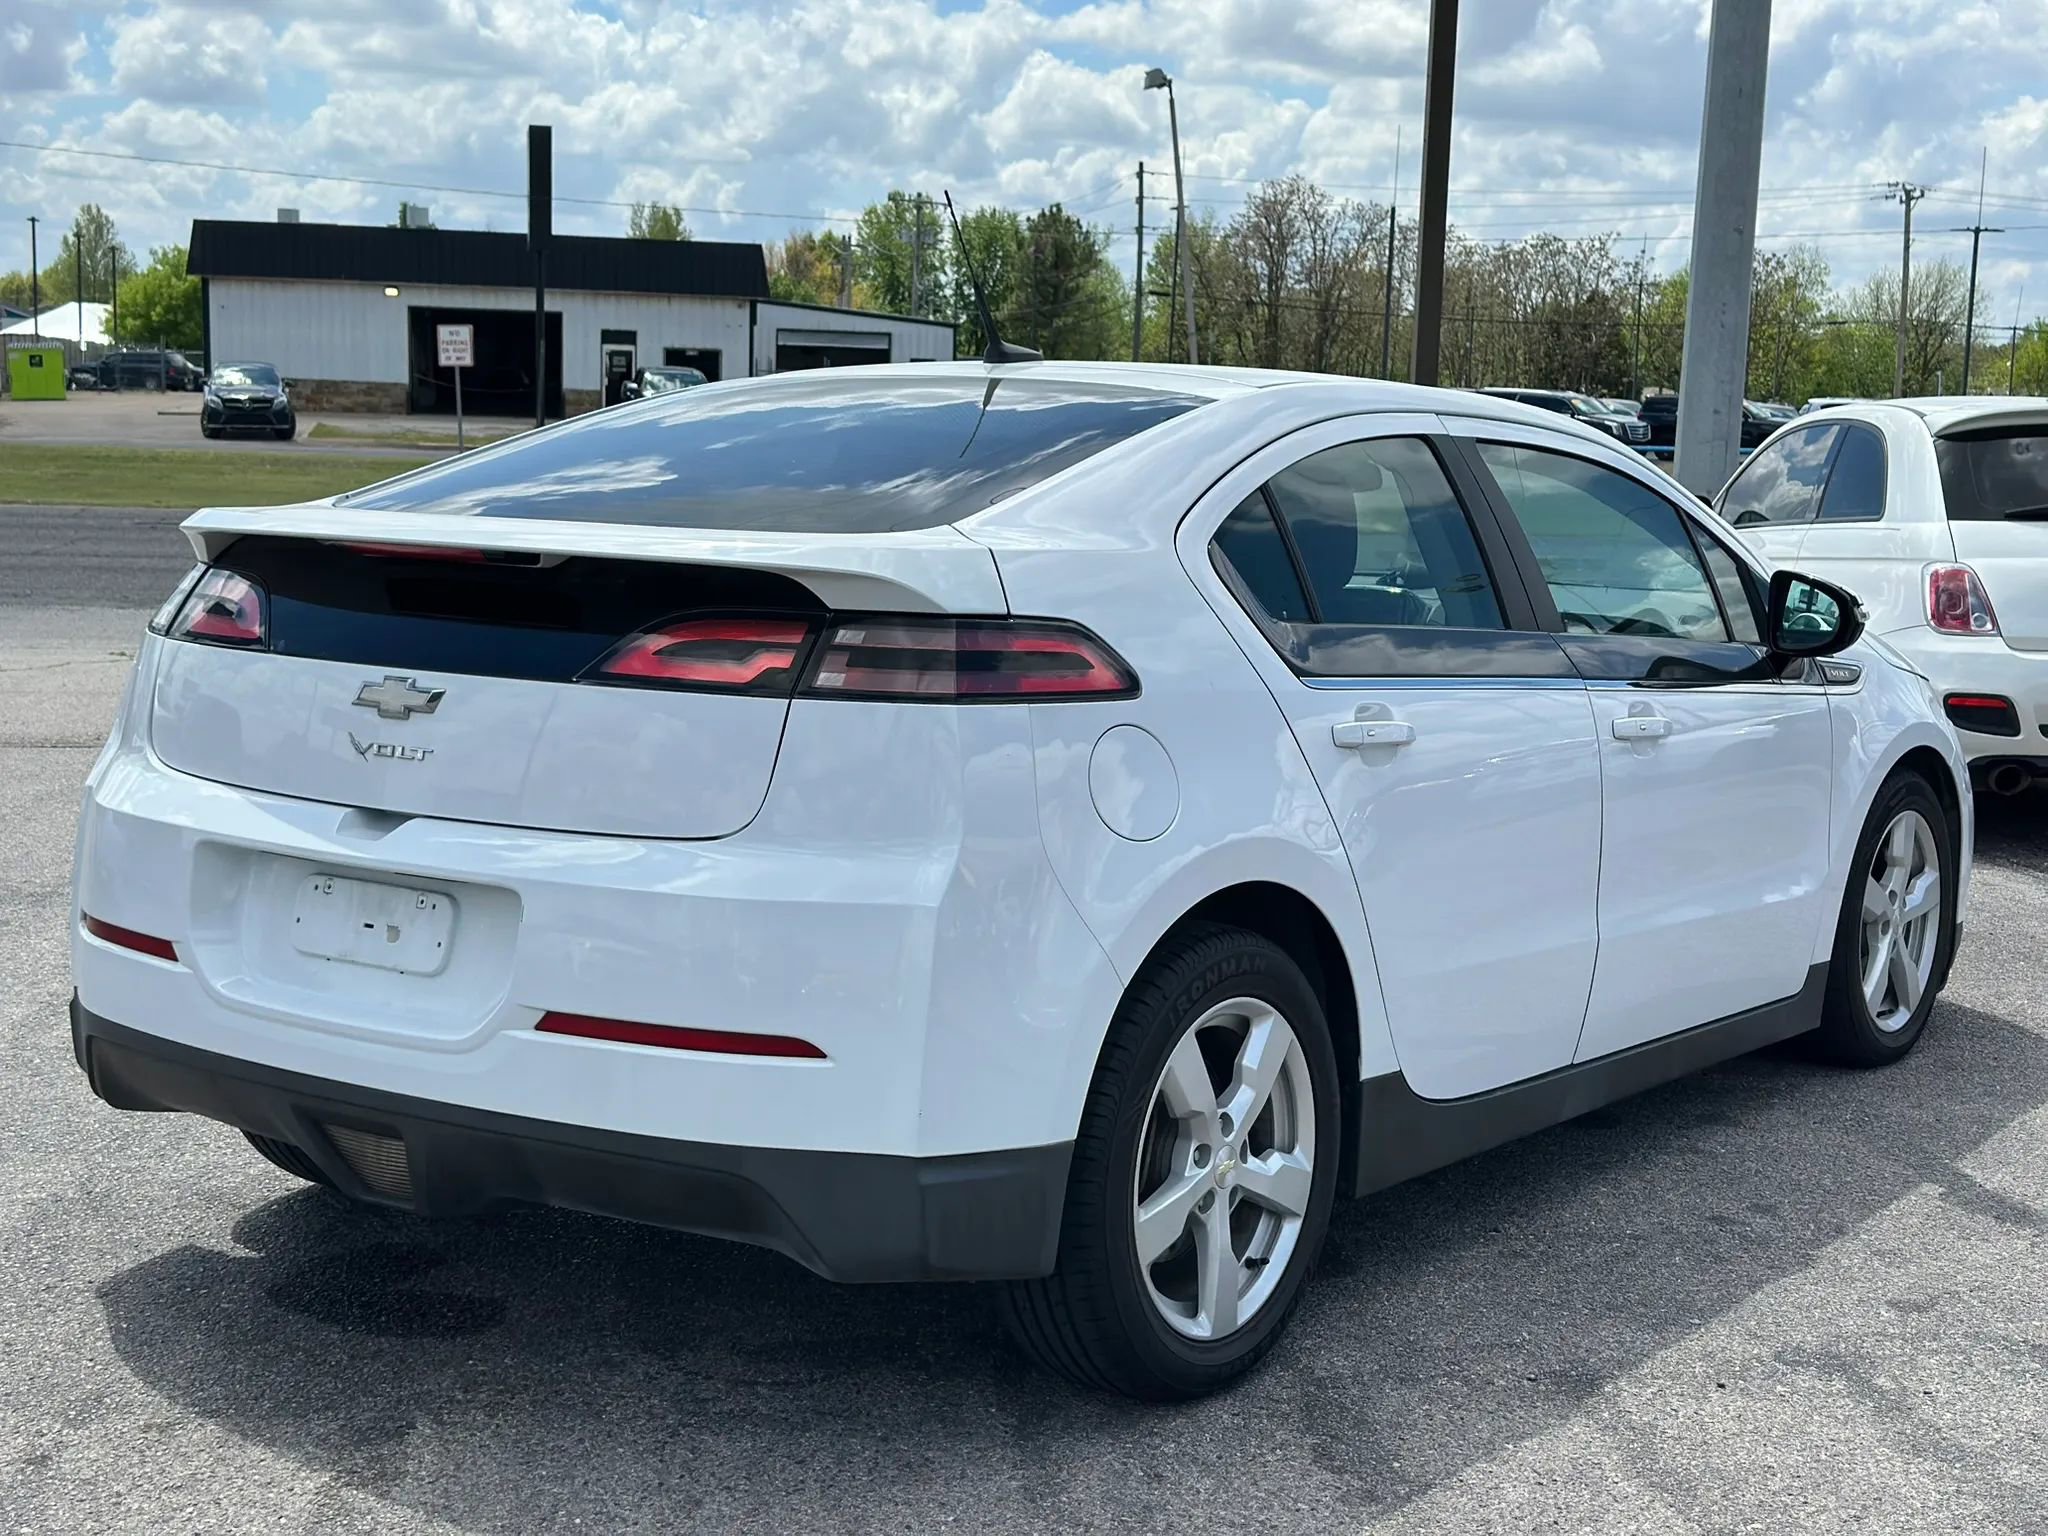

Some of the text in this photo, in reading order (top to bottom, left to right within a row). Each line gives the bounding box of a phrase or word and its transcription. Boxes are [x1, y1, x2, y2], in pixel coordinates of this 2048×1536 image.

[448, 329, 461, 337] NO
[348, 731, 434, 762] VOLT
[1168, 953, 1267, 1028] IRONMAN
